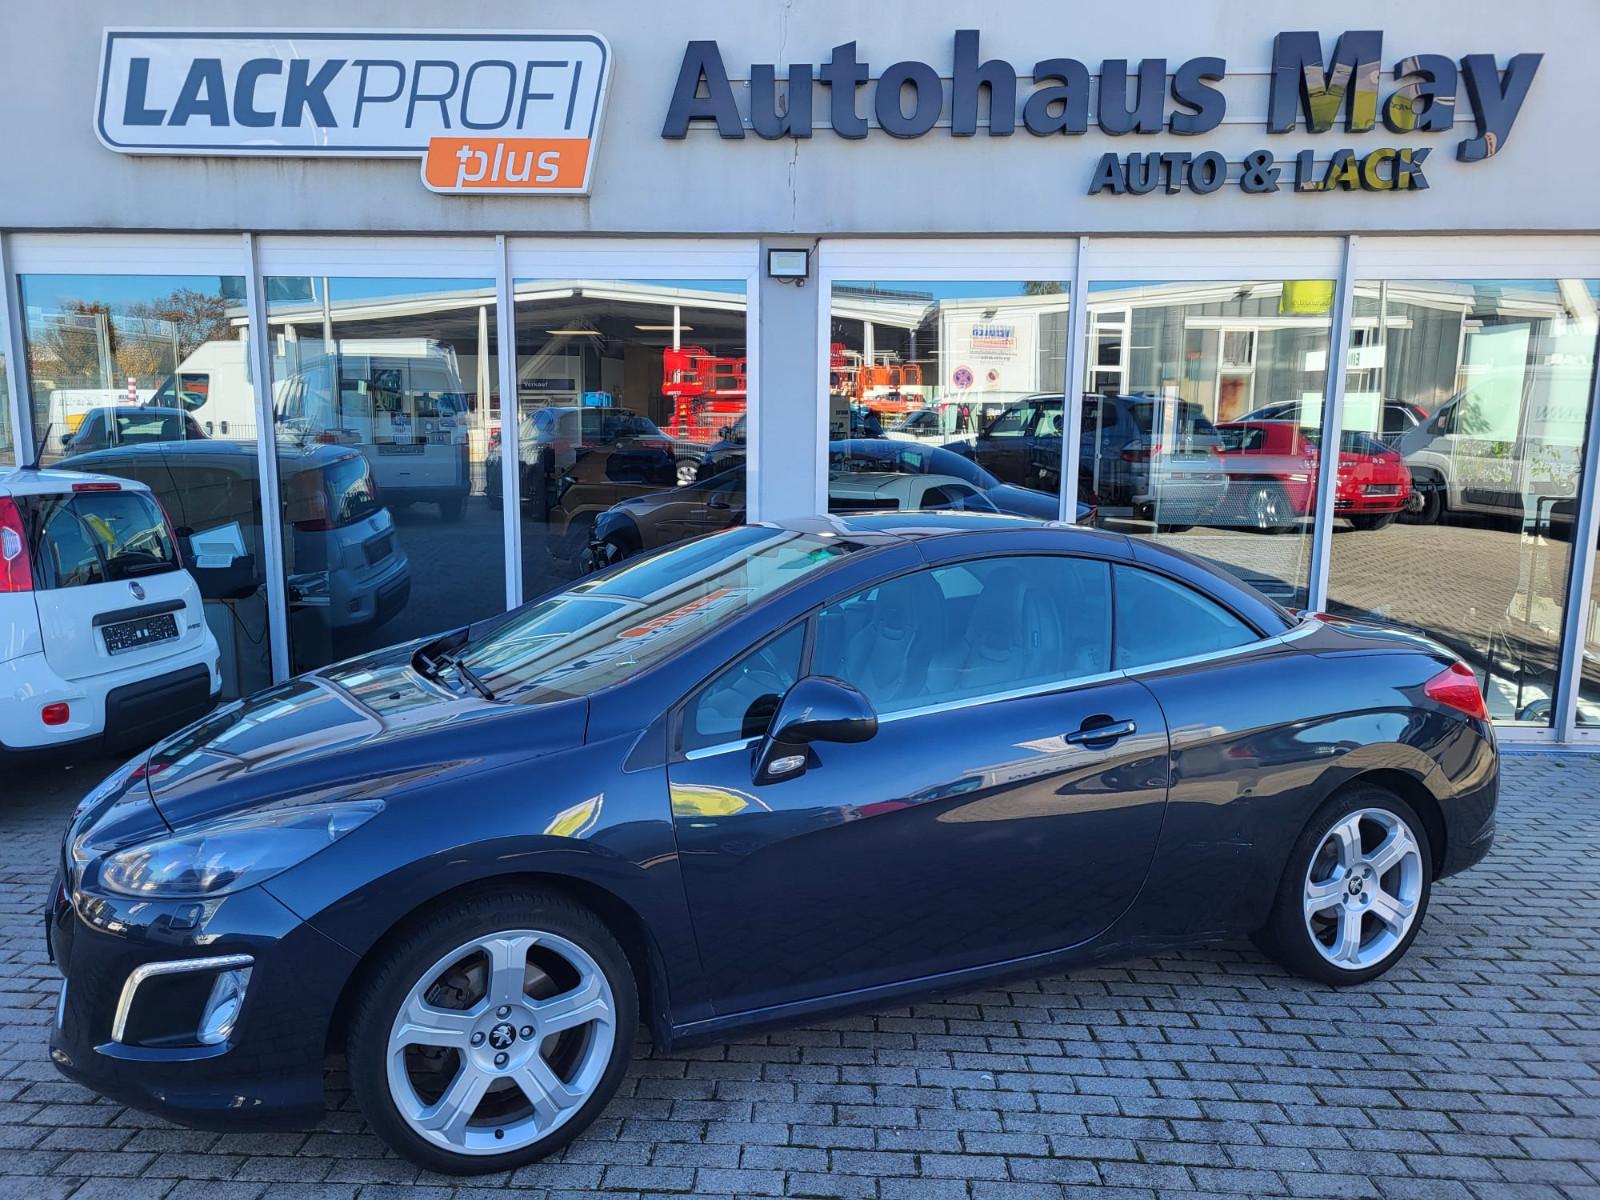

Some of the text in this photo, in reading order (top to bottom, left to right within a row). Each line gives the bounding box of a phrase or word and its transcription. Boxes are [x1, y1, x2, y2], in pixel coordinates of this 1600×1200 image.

[123, 56, 584, 131] LACKPROFI
[661, 29, 1545, 163] Autohaus May
[455, 144, 560, 189] plus
[1088, 147, 1434, 196] AUTO & LACK
